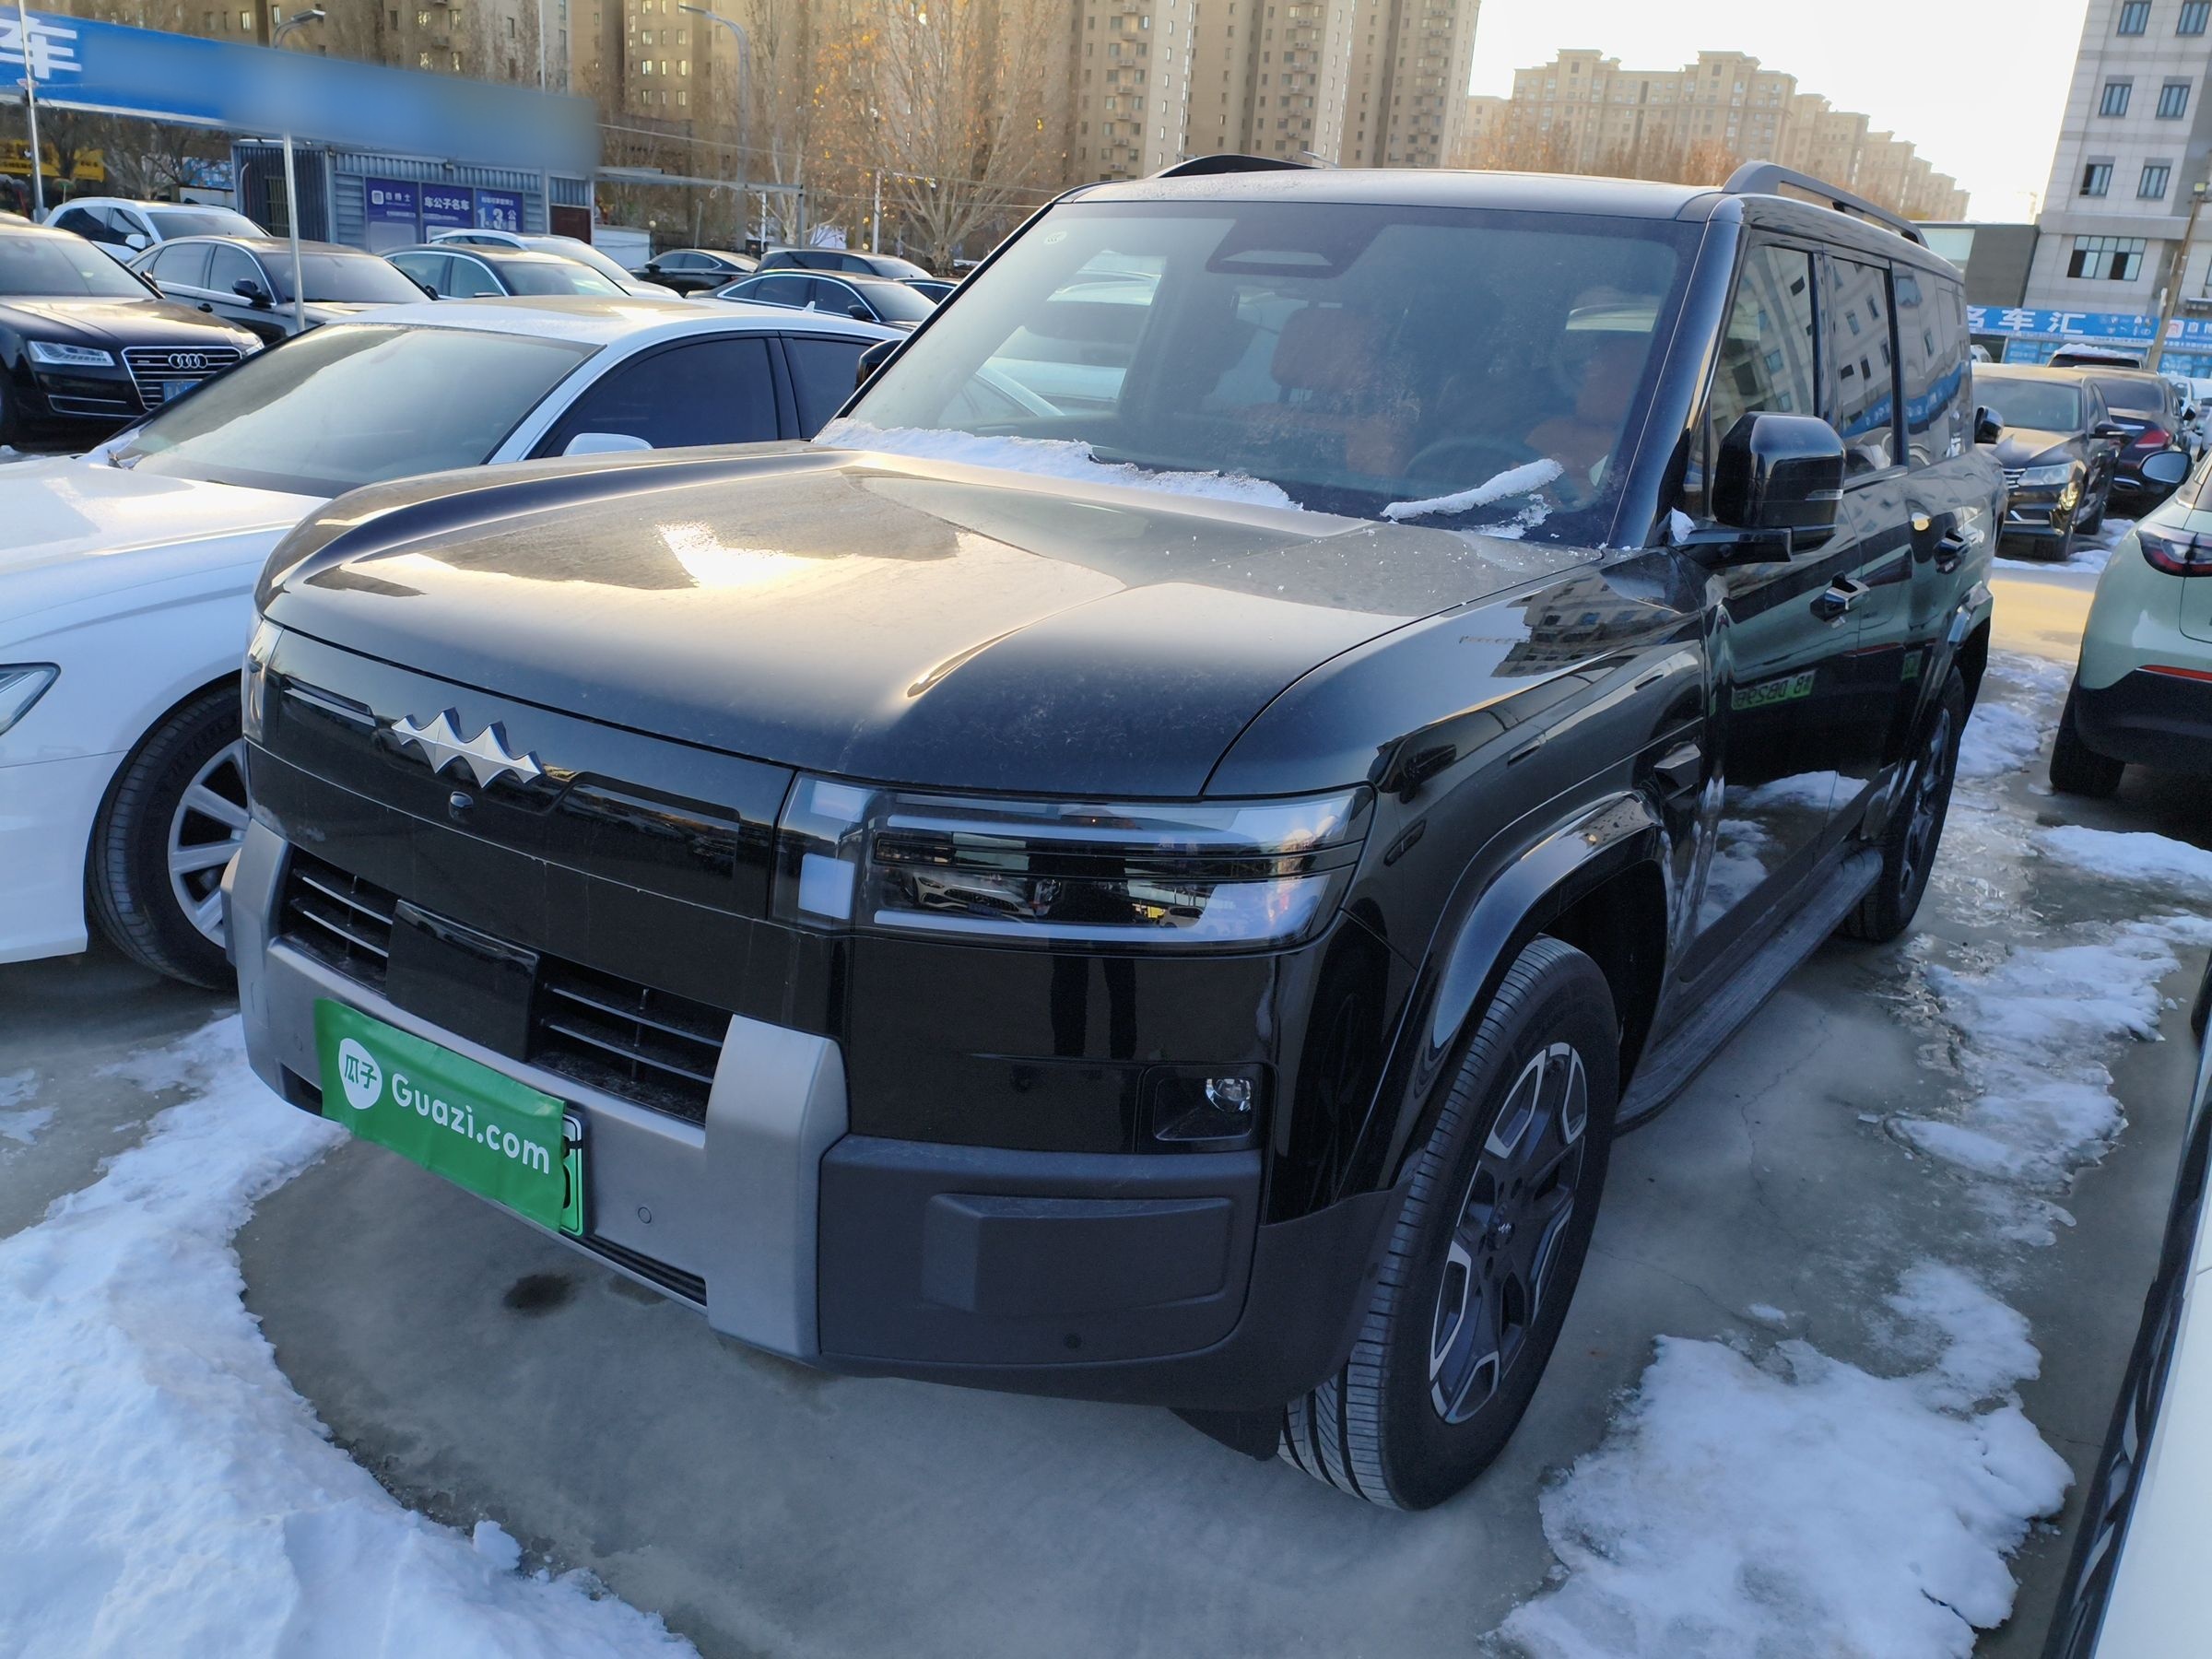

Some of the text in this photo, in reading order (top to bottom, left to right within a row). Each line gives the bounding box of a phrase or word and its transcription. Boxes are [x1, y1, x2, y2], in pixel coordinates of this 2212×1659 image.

[424, 196, 470, 211] 车公子名车
[345, 1053, 377, 1089] 瓜子
[392, 1073, 550, 1175] Guazi.com
